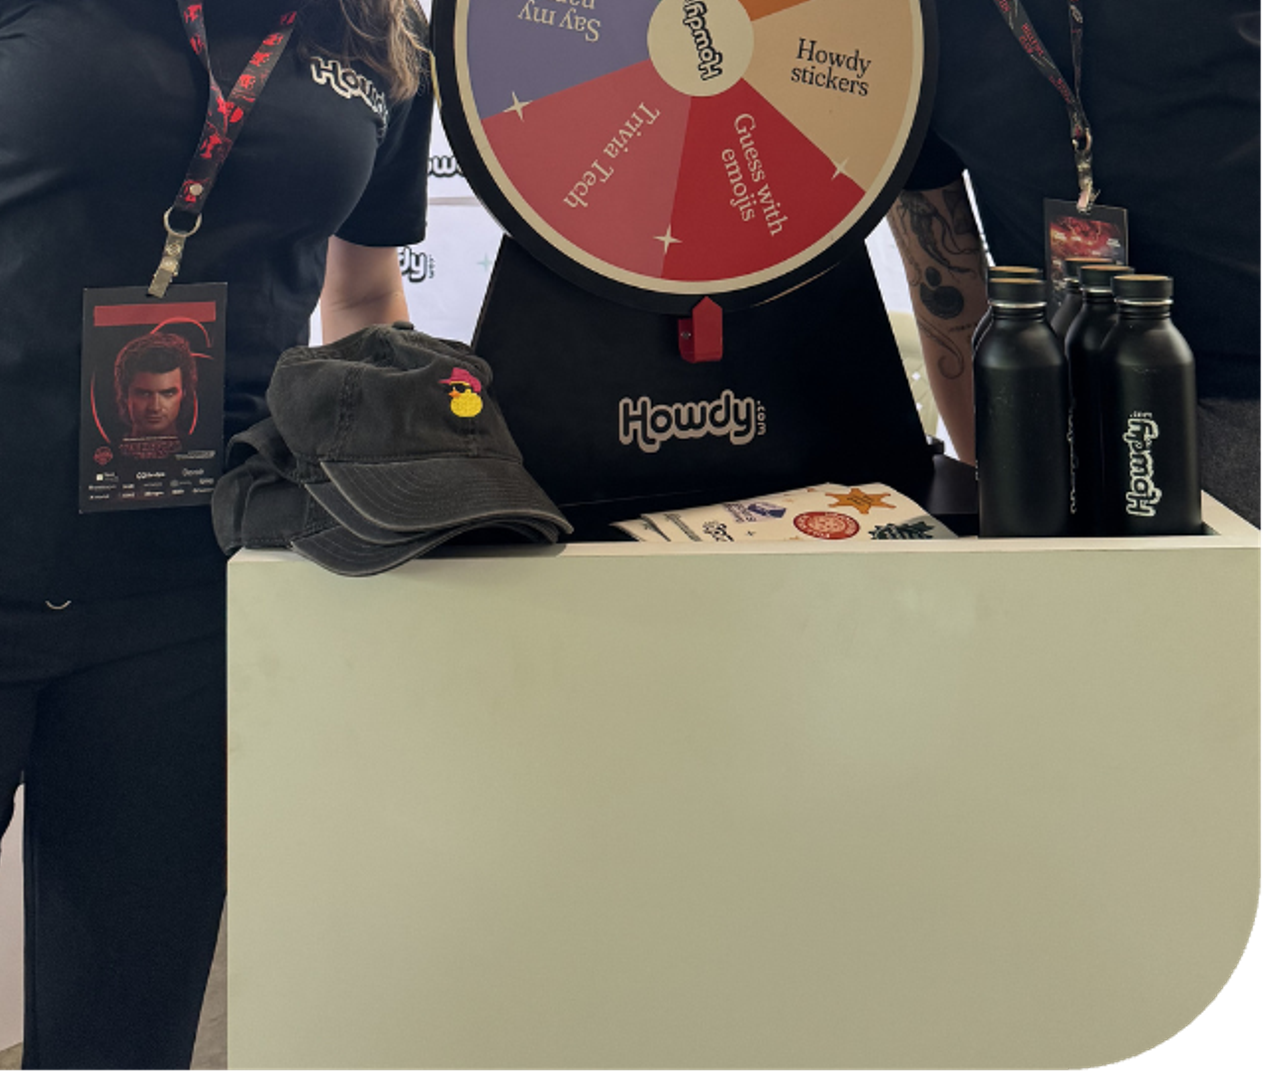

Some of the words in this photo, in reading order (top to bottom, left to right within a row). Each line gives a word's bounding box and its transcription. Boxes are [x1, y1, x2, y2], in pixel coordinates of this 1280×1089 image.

[559, 7, 602, 42] Say
[683, 0, 724, 81] Howdy
[791, 66, 870, 97] stickers
[796, 37, 872, 79] Howdy
[603, 101, 661, 159] Trivia
[563, 159, 615, 209] Tech
[721, 148, 758, 222] emojis
[733, 113, 766, 182] Guess
[756, 182, 789, 237] with
[618, 389, 756, 453] Howdy
[1122, 417, 1162, 517] Howdy
